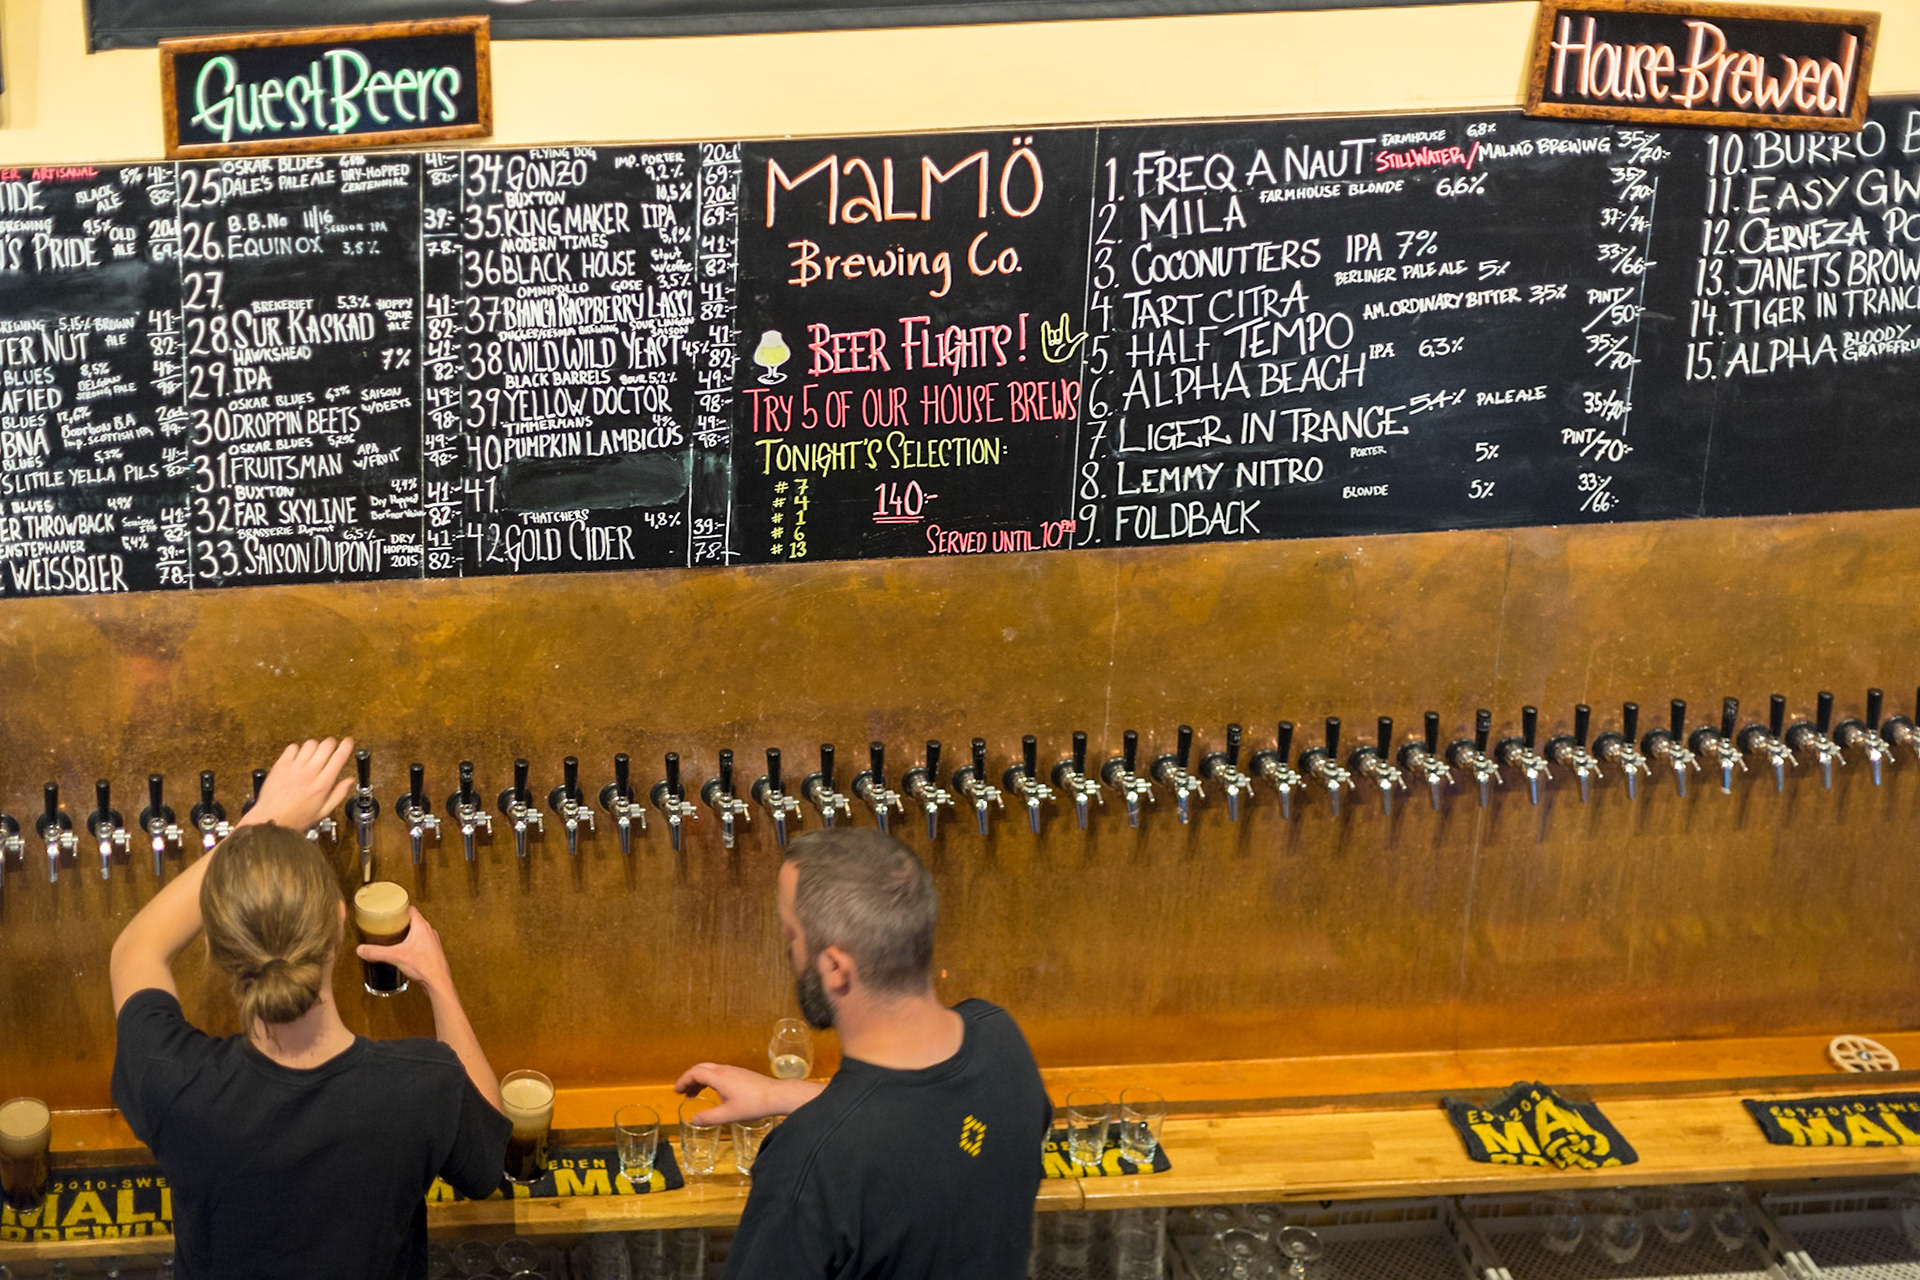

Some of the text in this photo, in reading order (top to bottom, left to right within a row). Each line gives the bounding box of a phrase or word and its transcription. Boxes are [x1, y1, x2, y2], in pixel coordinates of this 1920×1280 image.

[1550, 15, 1858, 115] House Brewed
[1382, 130, 1446, 146] FARMHOUSE
[1536, 136, 1612, 156] BREWING
[1752, 120, 1887, 169] BURRO
[222, 156, 325, 175] OSKAR BLUES
[530, 147, 597, 161] FLYING DOG
[614, 152, 685, 169] IMP. PORTER
[506, 155, 588, 191] GONZO
[1132, 138, 1377, 198] FREQ A NAUT
[223, 176, 274, 198] DALE'S
[504, 190, 566, 209] BUXTON
[1747, 175, 1850, 214] EASY
[1140, 180, 1404, 242] MILA FARMHOUSE BLONDE
[109, 227, 137, 242] OLD
[501, 233, 609, 253] MODERN TIMES
[1739, 216, 1870, 255] CERVEZA
[32, 233, 103, 272] PRIDE
[787, 231, 1023, 298] Brewing Co.
[1131, 230, 1438, 286] COCONUTTERS IPA 7%
[502, 250, 636, 285] BLACK HOUSE
[1333, 260, 1511, 287] BERLINER PALE ALE 5%
[1735, 251, 1842, 295] JANETS
[516, 281, 643, 299] OMNIPOLLO GOSE
[1465, 287, 1522, 306] BITTER
[251, 298, 314, 314] BREKERIET
[376, 299, 413, 309] HOPPY
[384, 311, 413, 321] SOUR
[557, 285, 693, 328] RASPBERRY LASSI
[1122, 280, 1310, 330] TART CITRA
[1728, 296, 1806, 334] TIGER
[1816, 292, 1838, 318] IN
[94, 317, 135, 332] BROWN
[387, 322, 412, 331] ALE
[1842, 323, 1912, 348] BLOODY
[41, 329, 90, 364] NUT
[105, 334, 127, 347] ALE
[507, 330, 685, 374] WILD WILD YEAST
[807, 322, 891, 377] BEER
[1126, 312, 1354, 368] HALF TEMPO
[233, 346, 312, 367] HAWKSHEAD
[381, 349, 412, 371] 7%
[1725, 333, 1838, 378] ALPHA
[3, 367, 55, 387] BLUES
[233, 367, 273, 394] IPA
[505, 370, 612, 390] BLACK BARRELS
[1122, 342, 1396, 412] ALPHA BEACH IPA
[228, 392, 315, 412] OSKAR BLUES
[361, 387, 402, 401] SAISON
[503, 386, 673, 422] YELLOW DOCTOR
[742, 378, 1081, 433] TRY 5 OF OUR HOUSE BREWS
[2, 414, 47, 429] BLUES
[307, 406, 360, 436] BEETS
[503, 416, 594, 437] TIMMERMANS
[1118, 405, 1409, 453] LIGER IN TRANCE
[1, 430, 50, 459] BNA
[228, 437, 313, 456] OSKAR BLUES
[357, 443, 379, 455] APA
[504, 425, 684, 462] PUMPKIN LAMBICUS
[754, 429, 1009, 478] TONIGHT'S SELECTION:
[2, 456, 44, 471] BLUES
[1117, 442, 1500, 496] LEMMY NITRO PORTER 5%
[15, 464, 160, 494] LITTLE YELLA PILS
[12, 500, 55, 513] BLUES
[234, 485, 295, 501] BUXTON
[234, 496, 359, 527] FAR SKYLINE
[519, 508, 590, 525] THATCHERS
[1114, 479, 1496, 542] FOLDBACK BLONDE 5%
[23, 514, 115, 540] THROWBACK
[237, 525, 294, 540] BRASSERIE
[390, 533, 416, 545] DRY
[925, 524, 987, 554] SERVED
[992, 530, 1041, 553] UNTIL
[245, 534, 385, 575] SAISON DUPONT
[383, 544, 423, 555] HOPPING
[504, 519, 636, 572] GOLD CIDER
[10, 554, 129, 592] WEISSBIER
[390, 554, 419, 568] 2015
